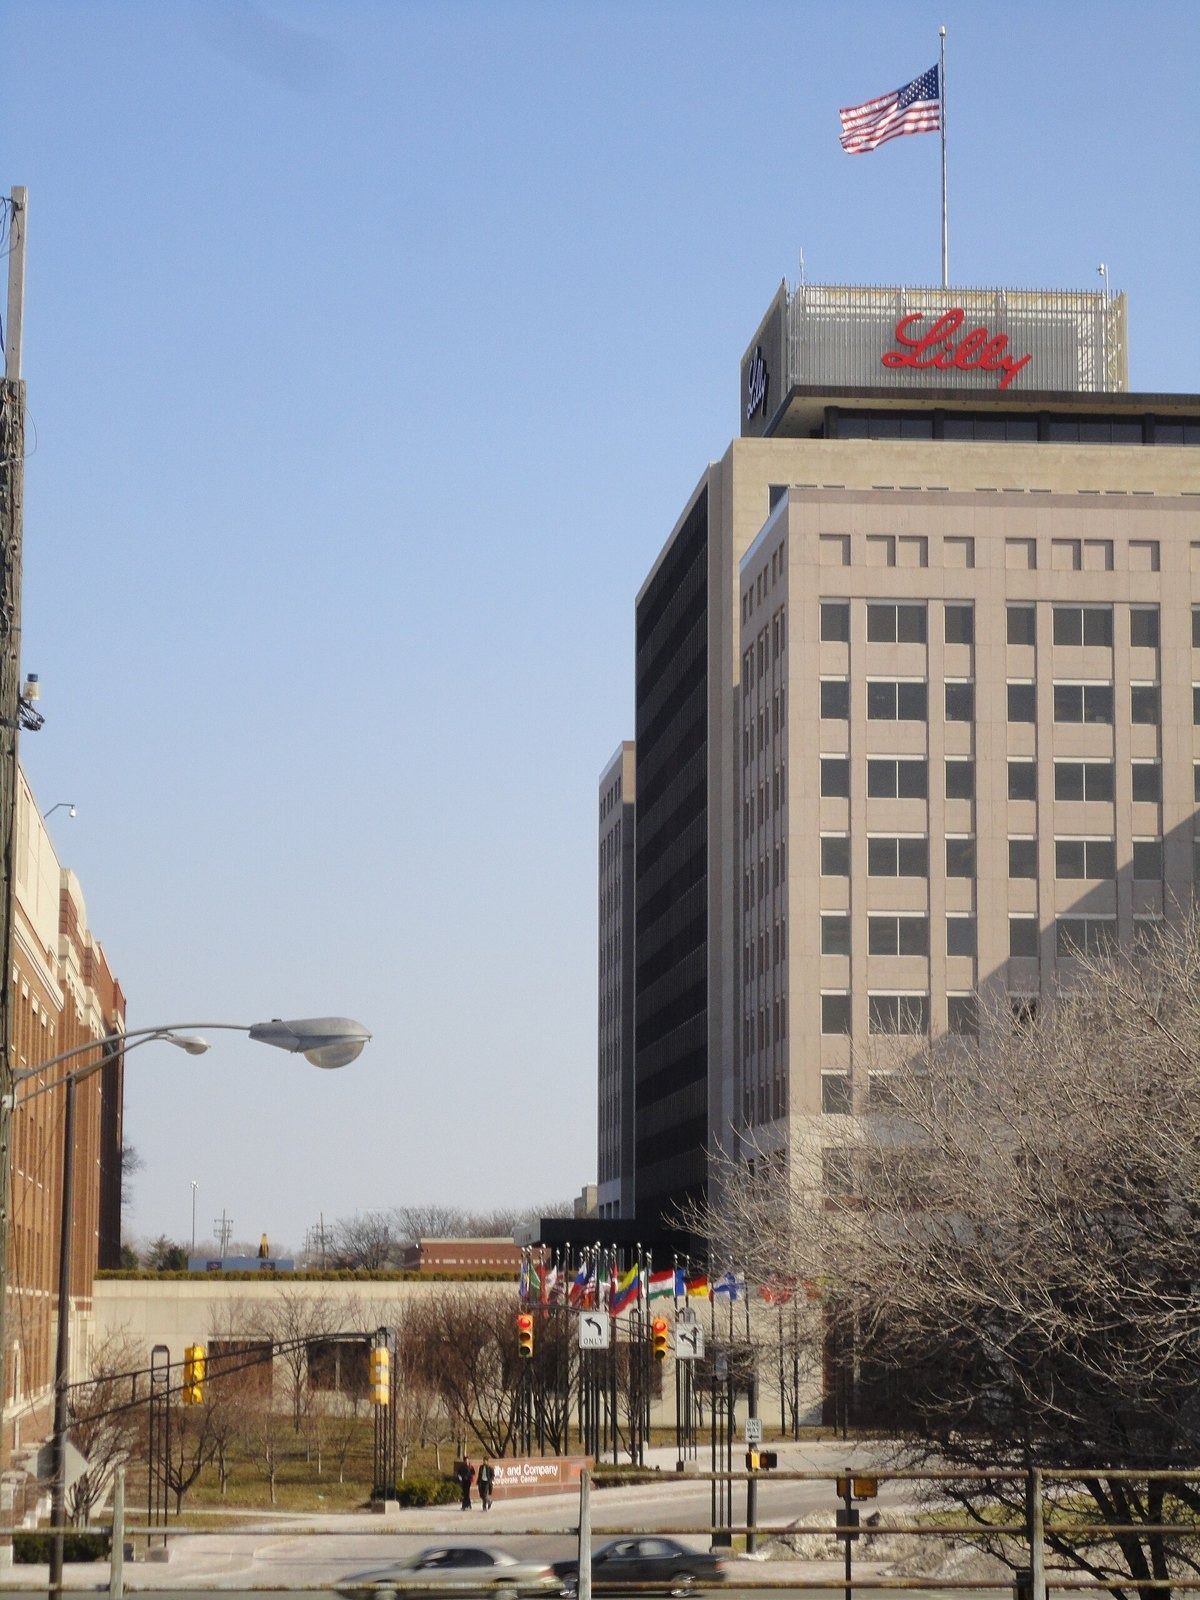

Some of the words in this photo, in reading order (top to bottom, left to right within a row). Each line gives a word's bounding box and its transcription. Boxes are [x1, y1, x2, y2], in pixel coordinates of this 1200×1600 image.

[882, 308, 1032, 390] Lilly
[583, 1337, 603, 1346] ONLY
[506, 1464, 521, 1476] and
[523, 1463, 558, 1477] Company
